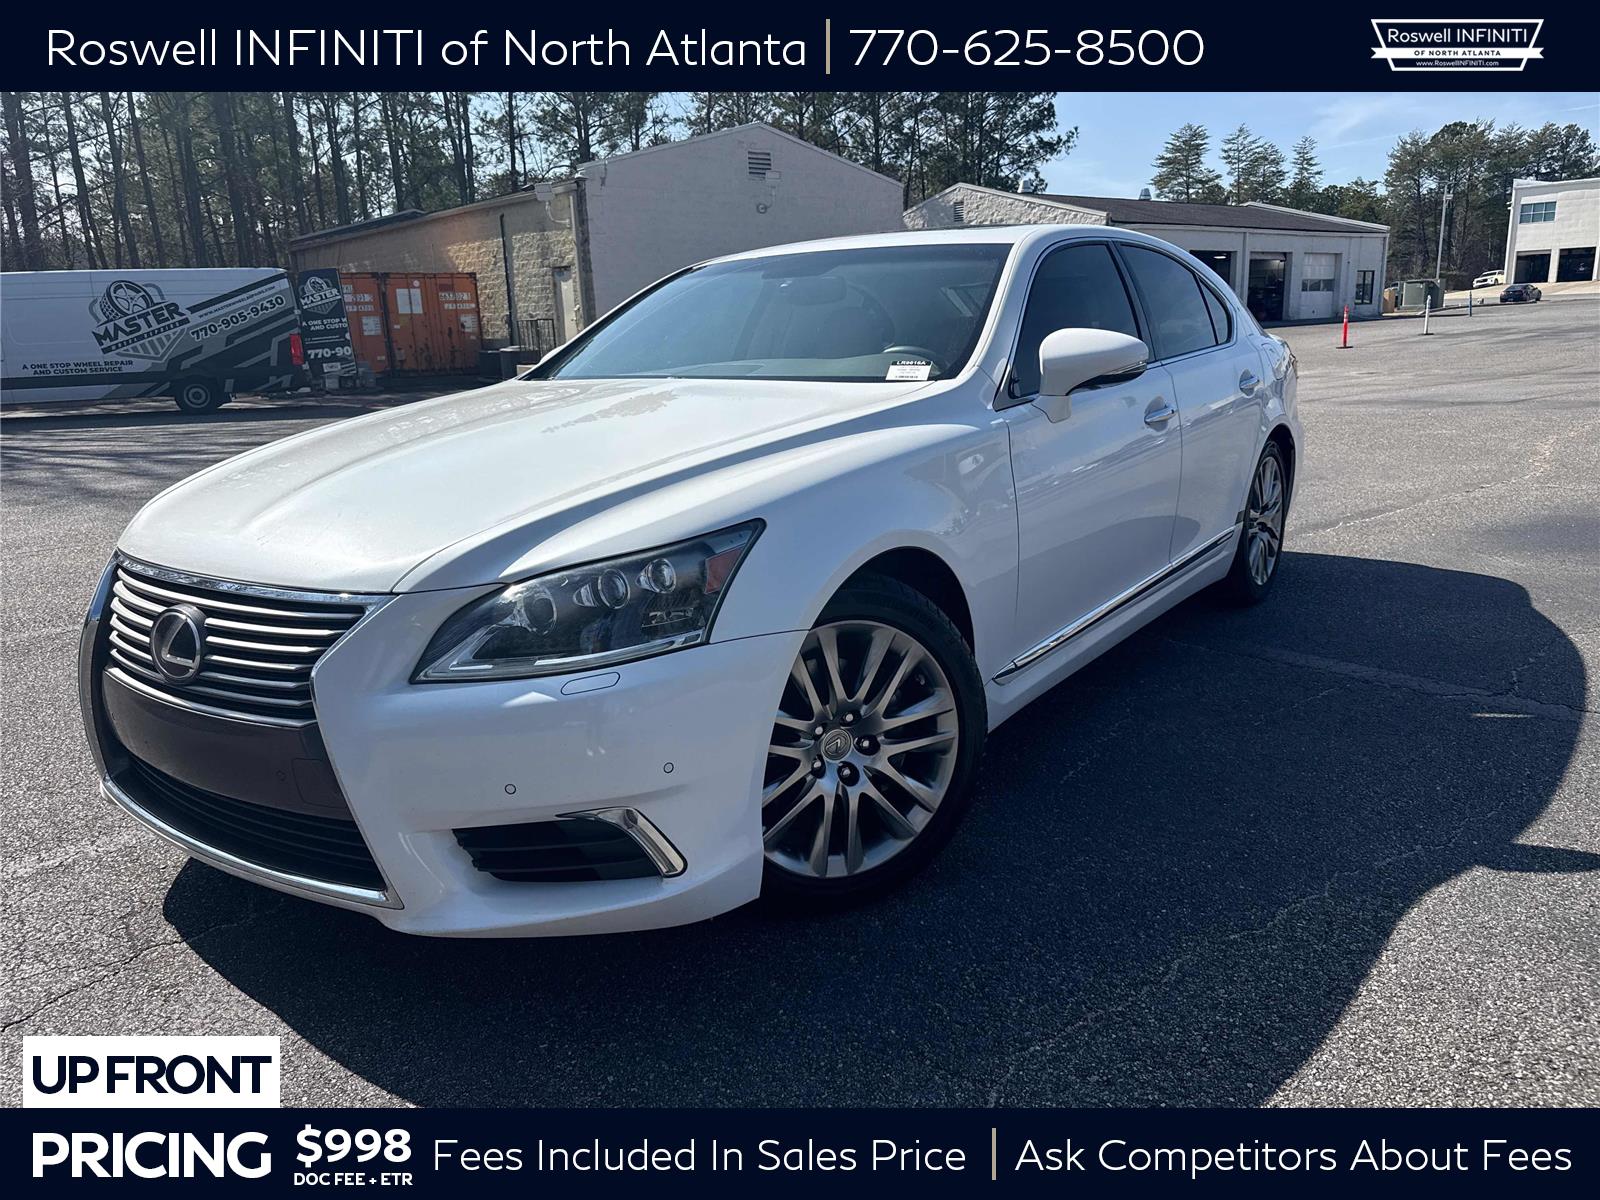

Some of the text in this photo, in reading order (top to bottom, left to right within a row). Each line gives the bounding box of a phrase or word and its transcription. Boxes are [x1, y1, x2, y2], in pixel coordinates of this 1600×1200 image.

[300, 288, 340, 305] MASTER
[92, 302, 187, 347] MASTER
[190, 295, 285, 341] 770-905-9430
[53, 367, 88, 375] CUSTOM
